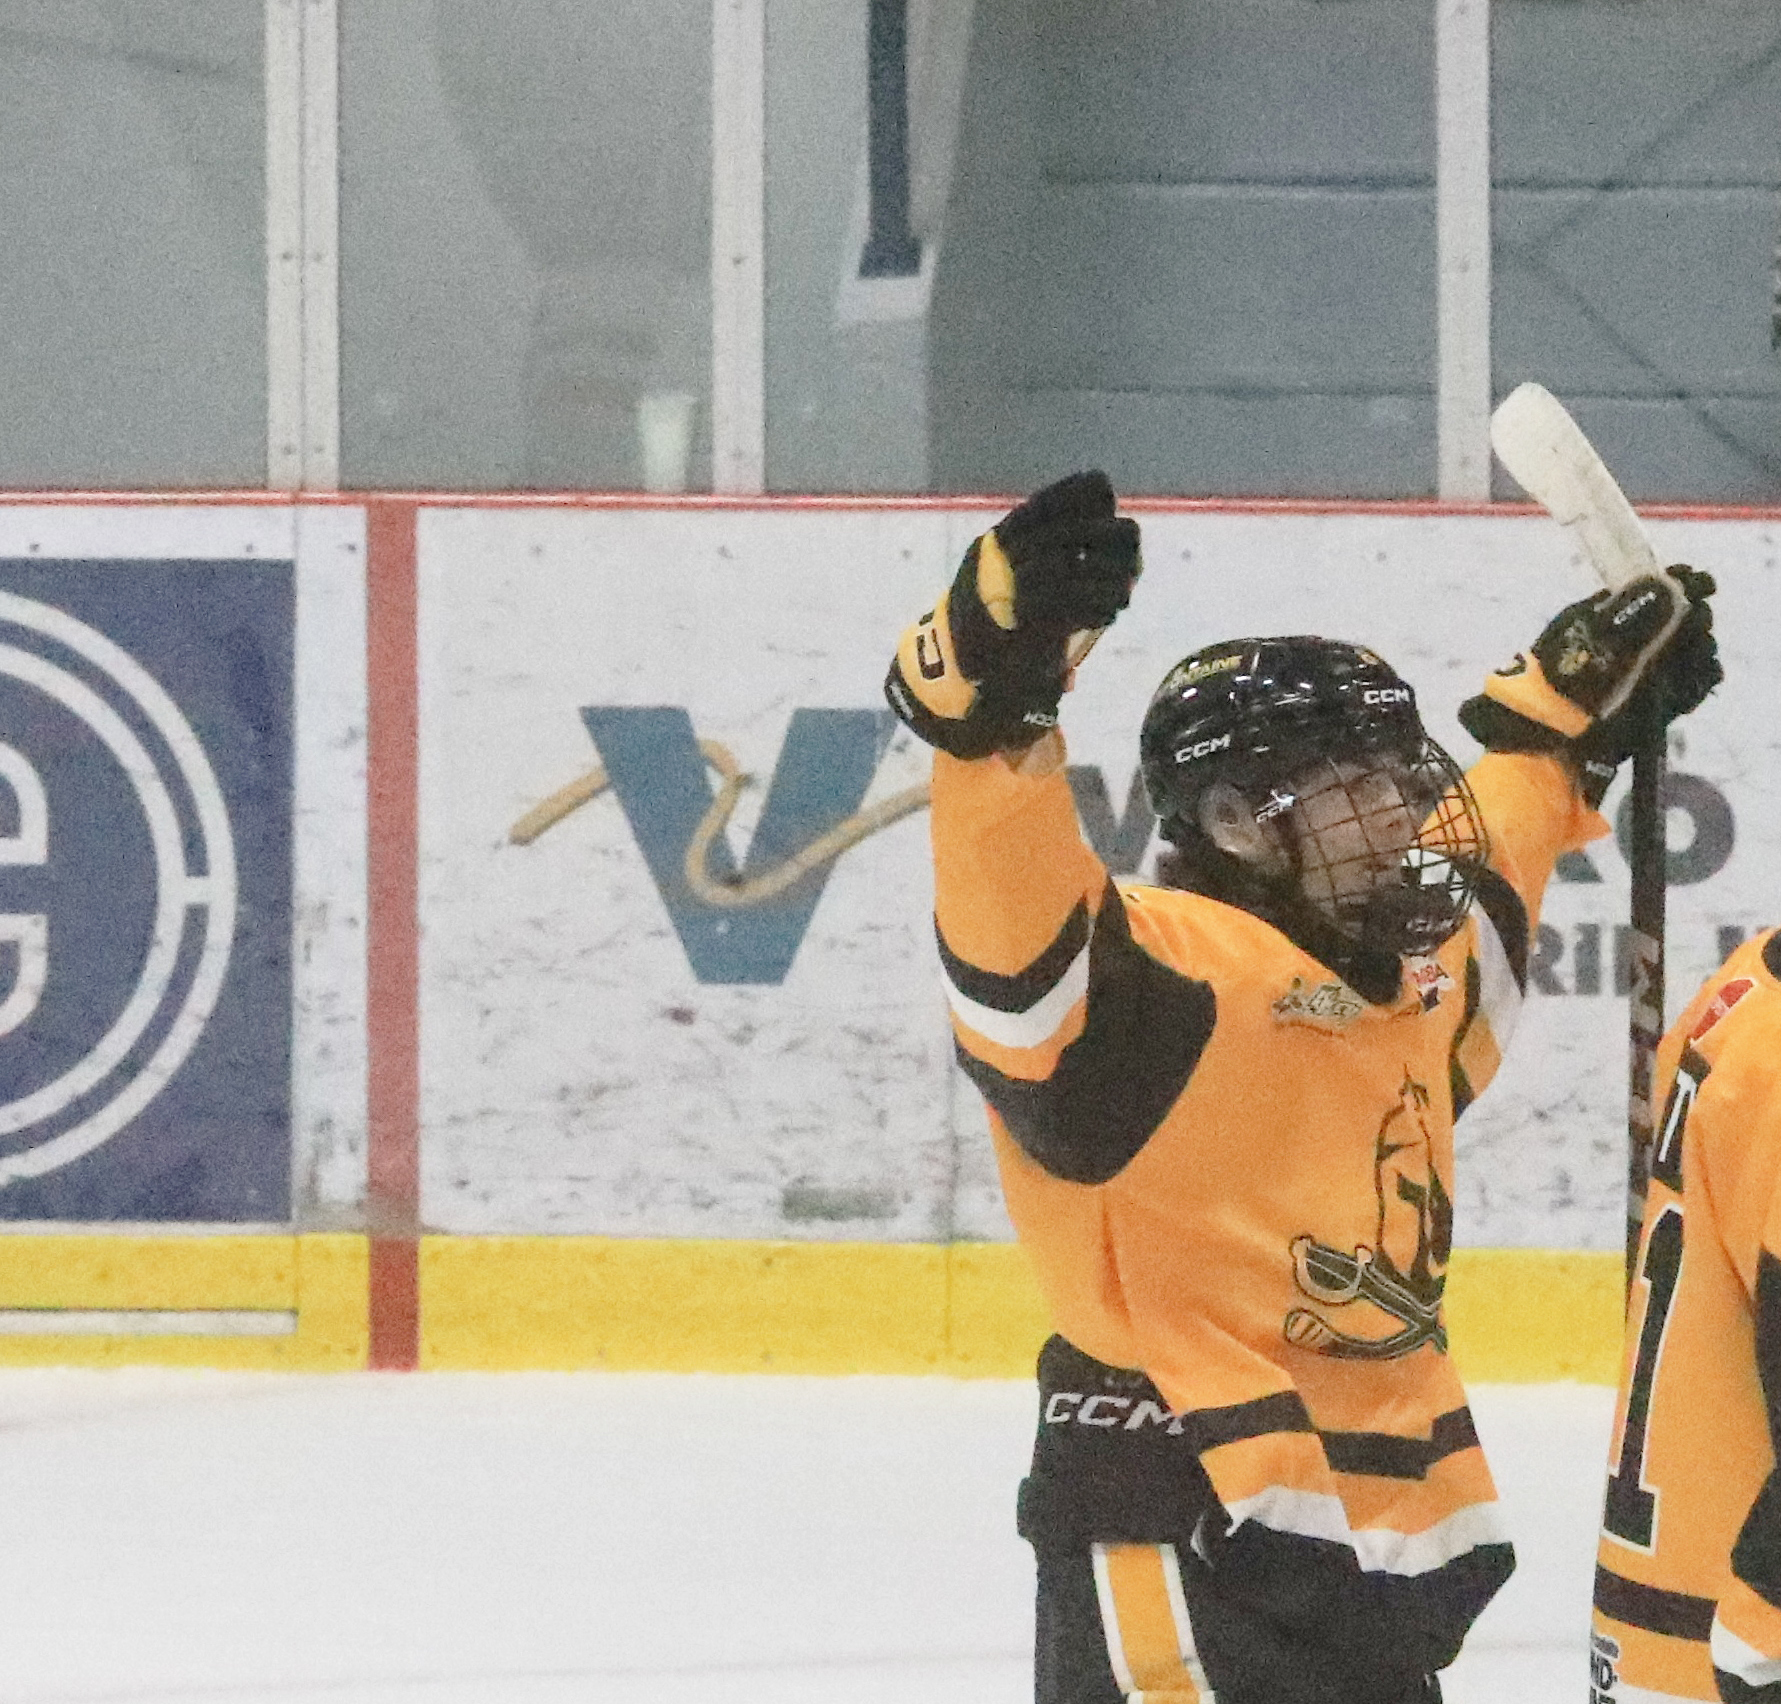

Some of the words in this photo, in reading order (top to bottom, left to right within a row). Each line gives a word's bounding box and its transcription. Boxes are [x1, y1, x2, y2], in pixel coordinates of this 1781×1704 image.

[1363, 687, 1411, 705] CCM
[1174, 733, 1232, 764] CCM
[1044, 1391, 1186, 1437] CCM
